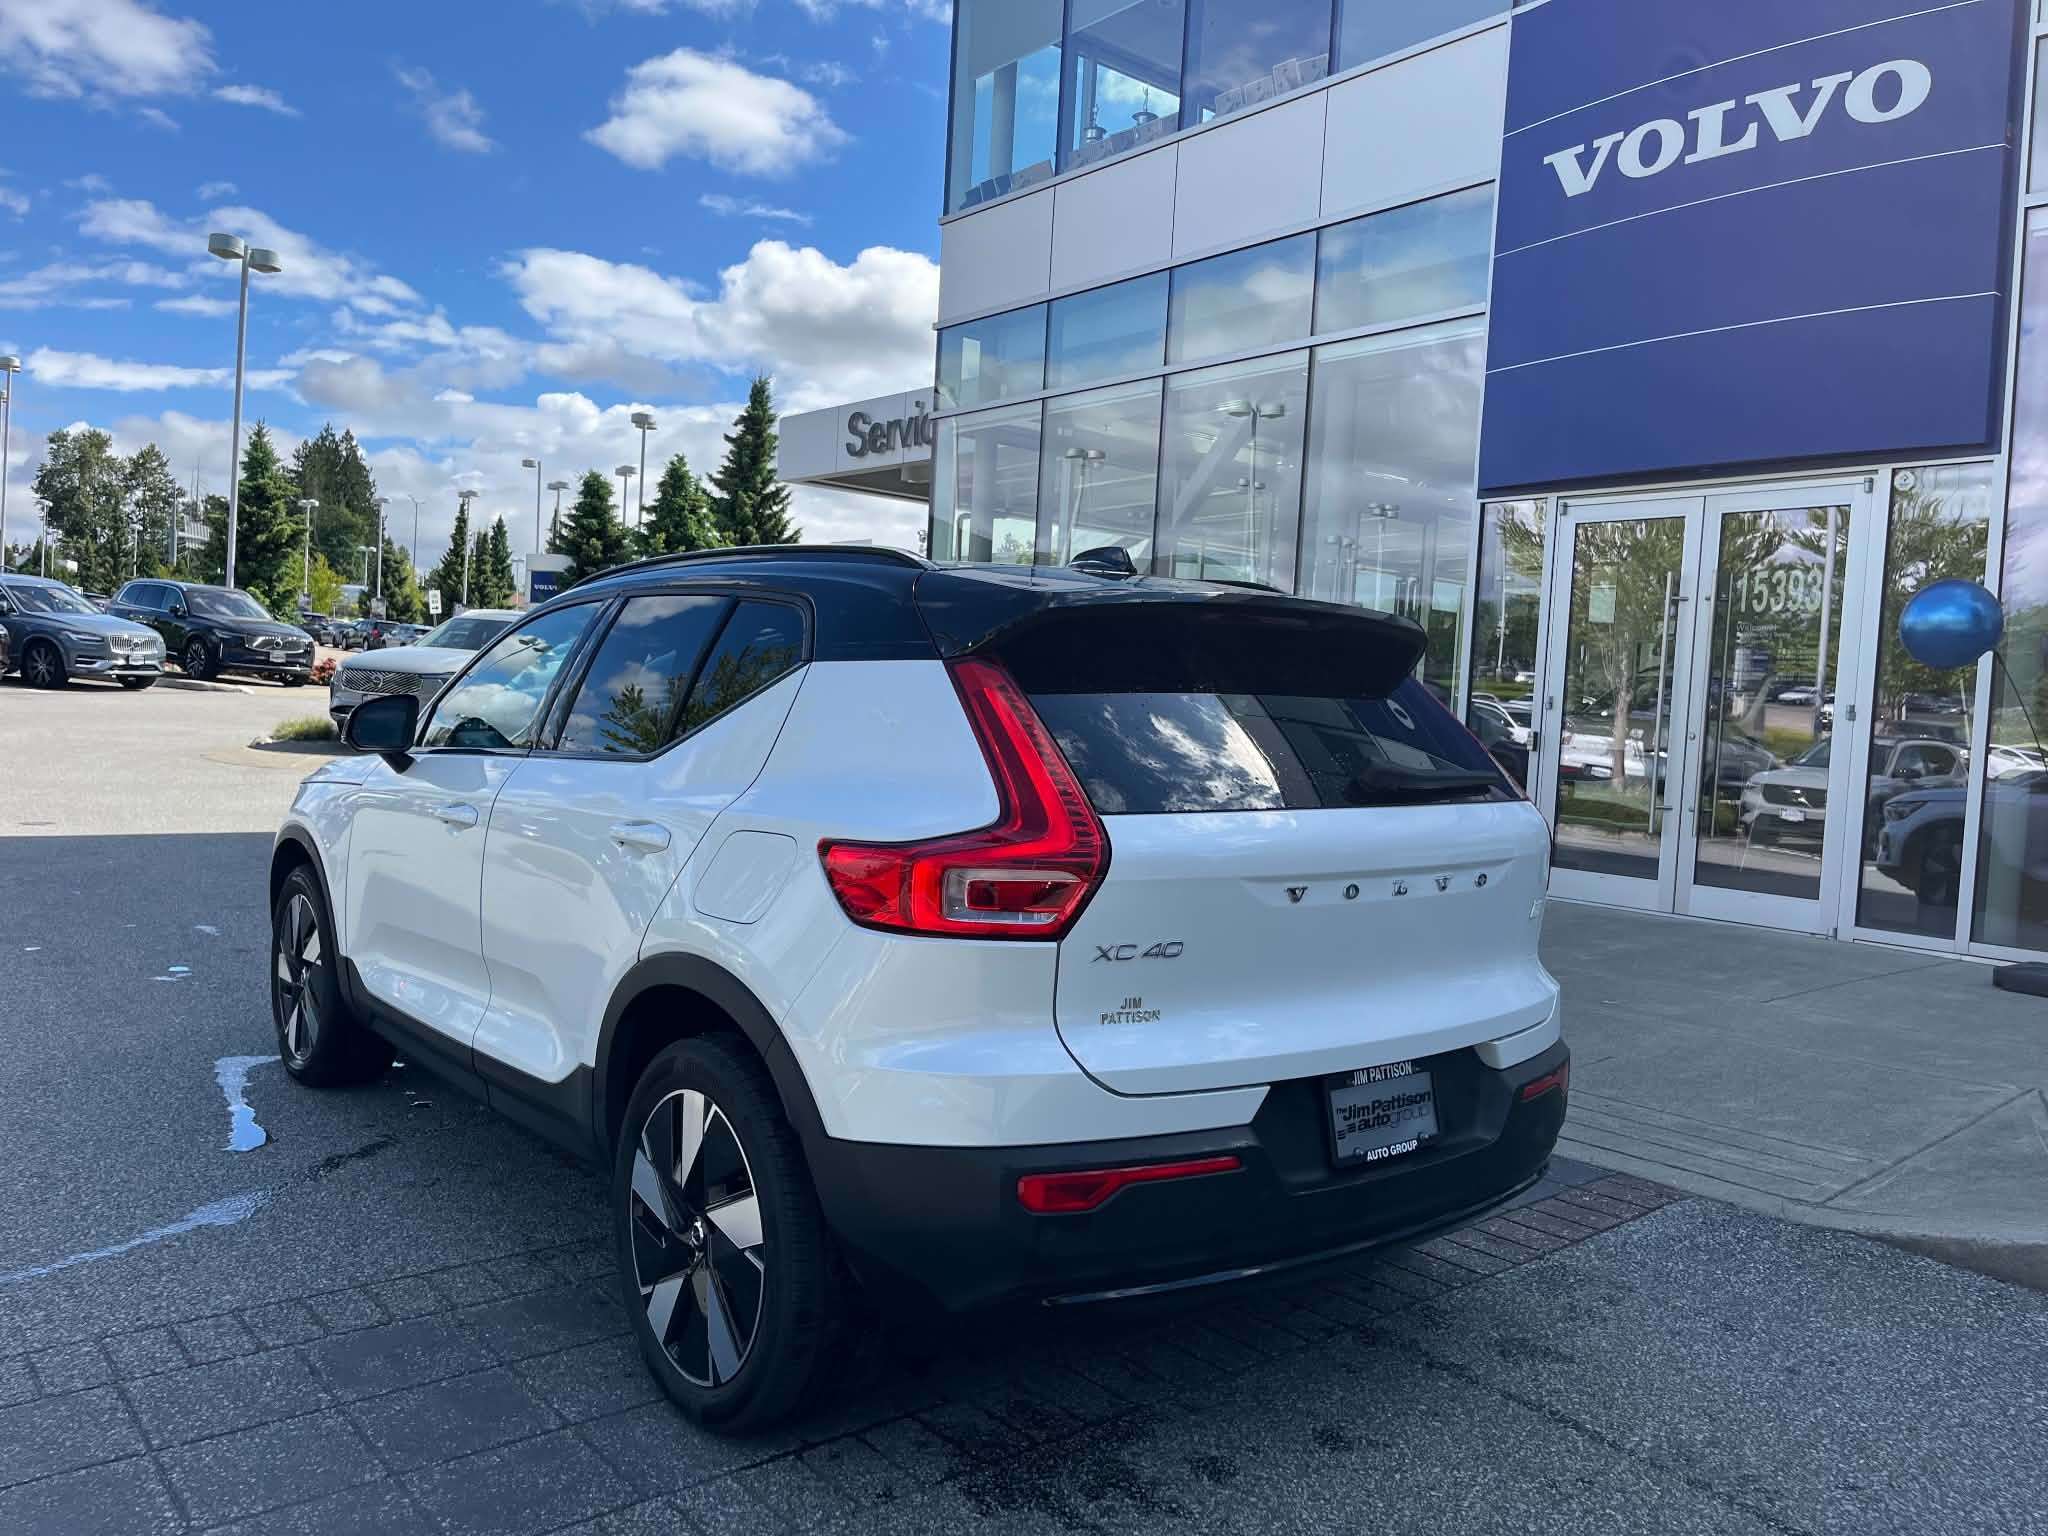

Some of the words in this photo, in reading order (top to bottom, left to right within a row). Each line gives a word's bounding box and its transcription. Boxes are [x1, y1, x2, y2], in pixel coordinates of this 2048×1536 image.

[1544, 59, 1931, 198] VOLVO
[1737, 568, 1822, 613] 15393
[1285, 873, 1488, 904] VOLVO
[1120, 997, 1142, 1010] JIM
[1100, 1009, 1161, 1025] PATTISON
[1352, 1069, 1368, 1086] JIM
[1369, 1061, 1412, 1082] PATTISON
[1366, 1147, 1389, 1161] AUTO
[1390, 1139, 1418, 1156] GROUP
